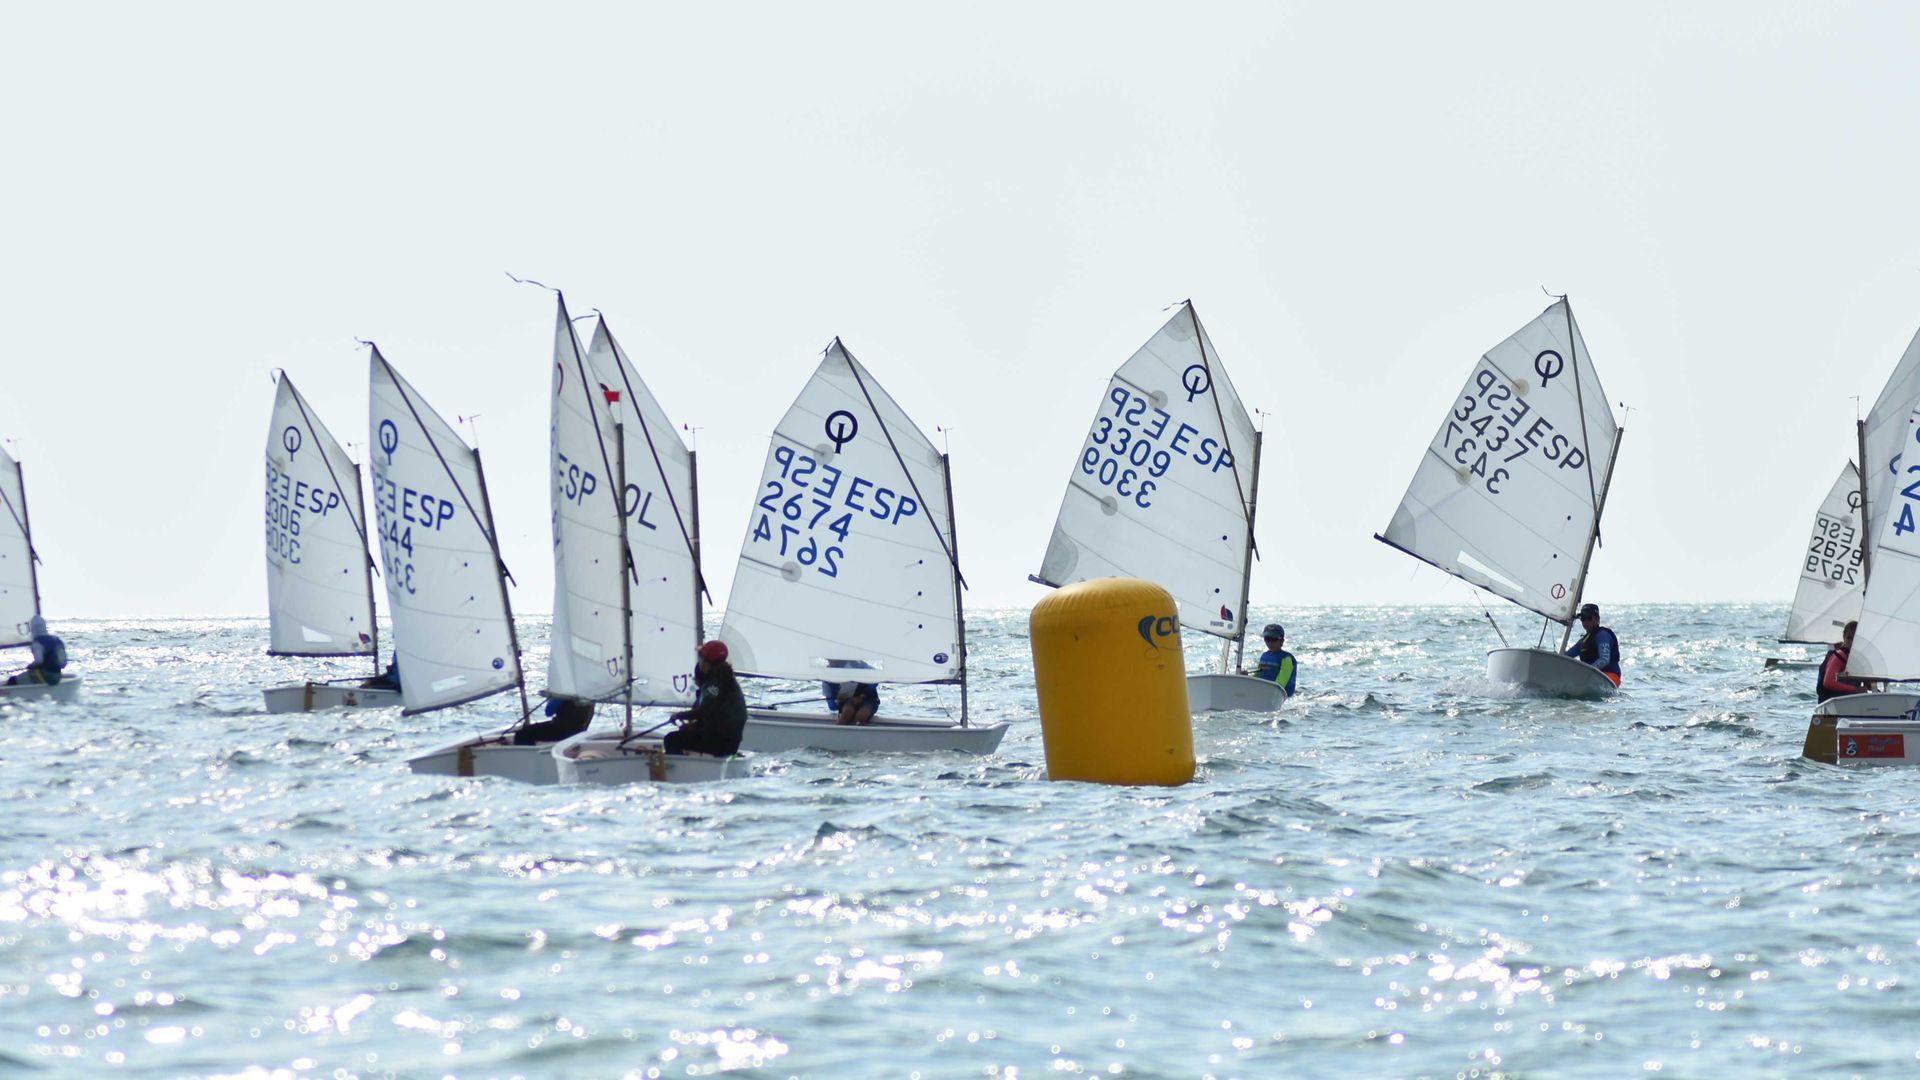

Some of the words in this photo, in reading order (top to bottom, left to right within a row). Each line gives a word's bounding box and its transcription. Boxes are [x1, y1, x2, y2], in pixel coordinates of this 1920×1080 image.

[1092, 416, 1171, 478] 3309
[1169, 422, 1234, 473] ESP
[1454, 395, 1530, 463] 3437
[1523, 416, 1585, 470] ESP
[294, 480, 340, 517] ESP
[402, 487, 455, 532] ESP
[624, 483, 657, 531] OL
[758, 480, 853, 543] 2674
[844, 476, 918, 526] ESP
[1810, 535, 1863, 567] 2679
